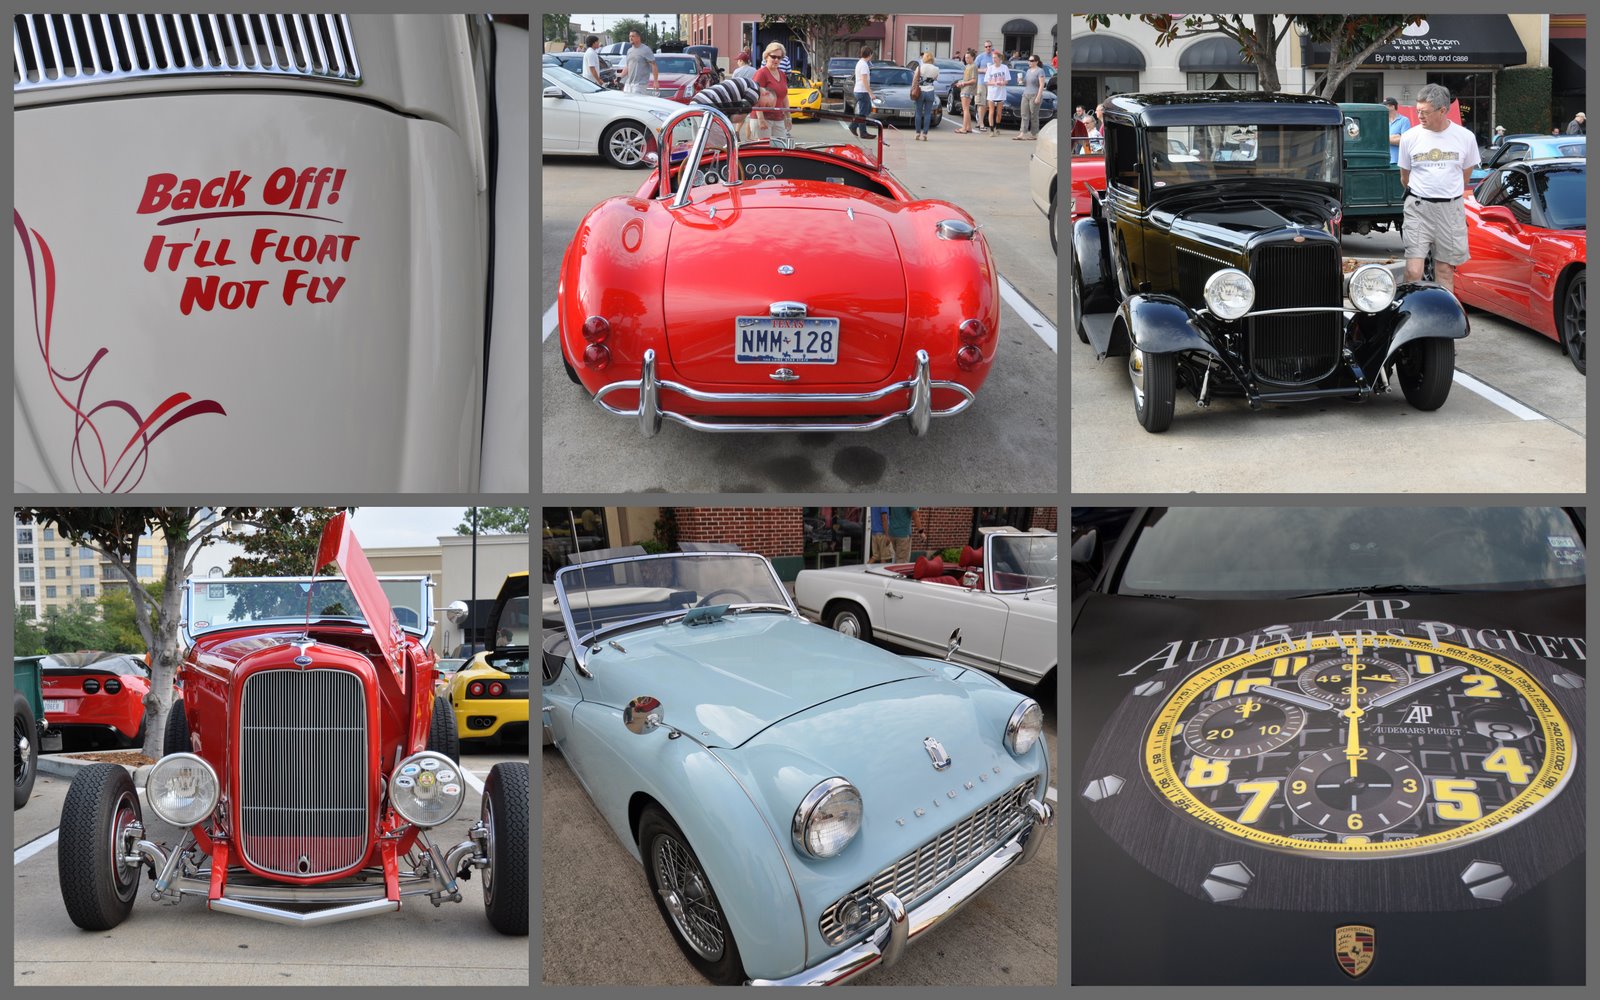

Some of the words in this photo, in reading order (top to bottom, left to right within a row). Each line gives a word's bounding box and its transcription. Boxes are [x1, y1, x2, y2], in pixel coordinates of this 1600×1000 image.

[1395, 38, 1430, 47] Tasting
[1375, 54, 1384, 63] By
[1386, 54, 1396, 62] the
[1398, 54, 1417, 63] glass,
[1419, 54, 1437, 62] bottle
[1438, 54, 1451, 62] and
[136, 170, 252, 214] Back
[263, 167, 347, 210] Off!
[144, 228, 236, 272] IT'LL
[250, 228, 360, 265] FLOAT
[180, 275, 269, 316] NOT
[282, 269, 346, 306] FLY
[772, 320, 804, 328] TEXAS
[1323, 599, 1411, 622] AP
[1118, 628, 1405, 677] AUDEMARS
[1418, 622, 1586, 660] PIGUET
[1492, 663, 1514, 675] 400
[1316, 674, 1341, 683] 45
[1460, 674, 1503, 698] 2
[1404, 705, 1433, 724] AP
[1206, 728, 1234, 741] 20
[1258, 725, 1281, 736] 10
[1373, 726, 1425, 734] AUDEMARS
[1427, 727, 1462, 736] PIGUET
[1483, 747, 1534, 784] 4
[1291, 780, 1307, 795] 9
[1402, 778, 1418, 794] 3
[1235, 781, 1280, 823] 7
[1432, 778, 1482, 821] 5
[1346, 813, 1364, 831] 6
